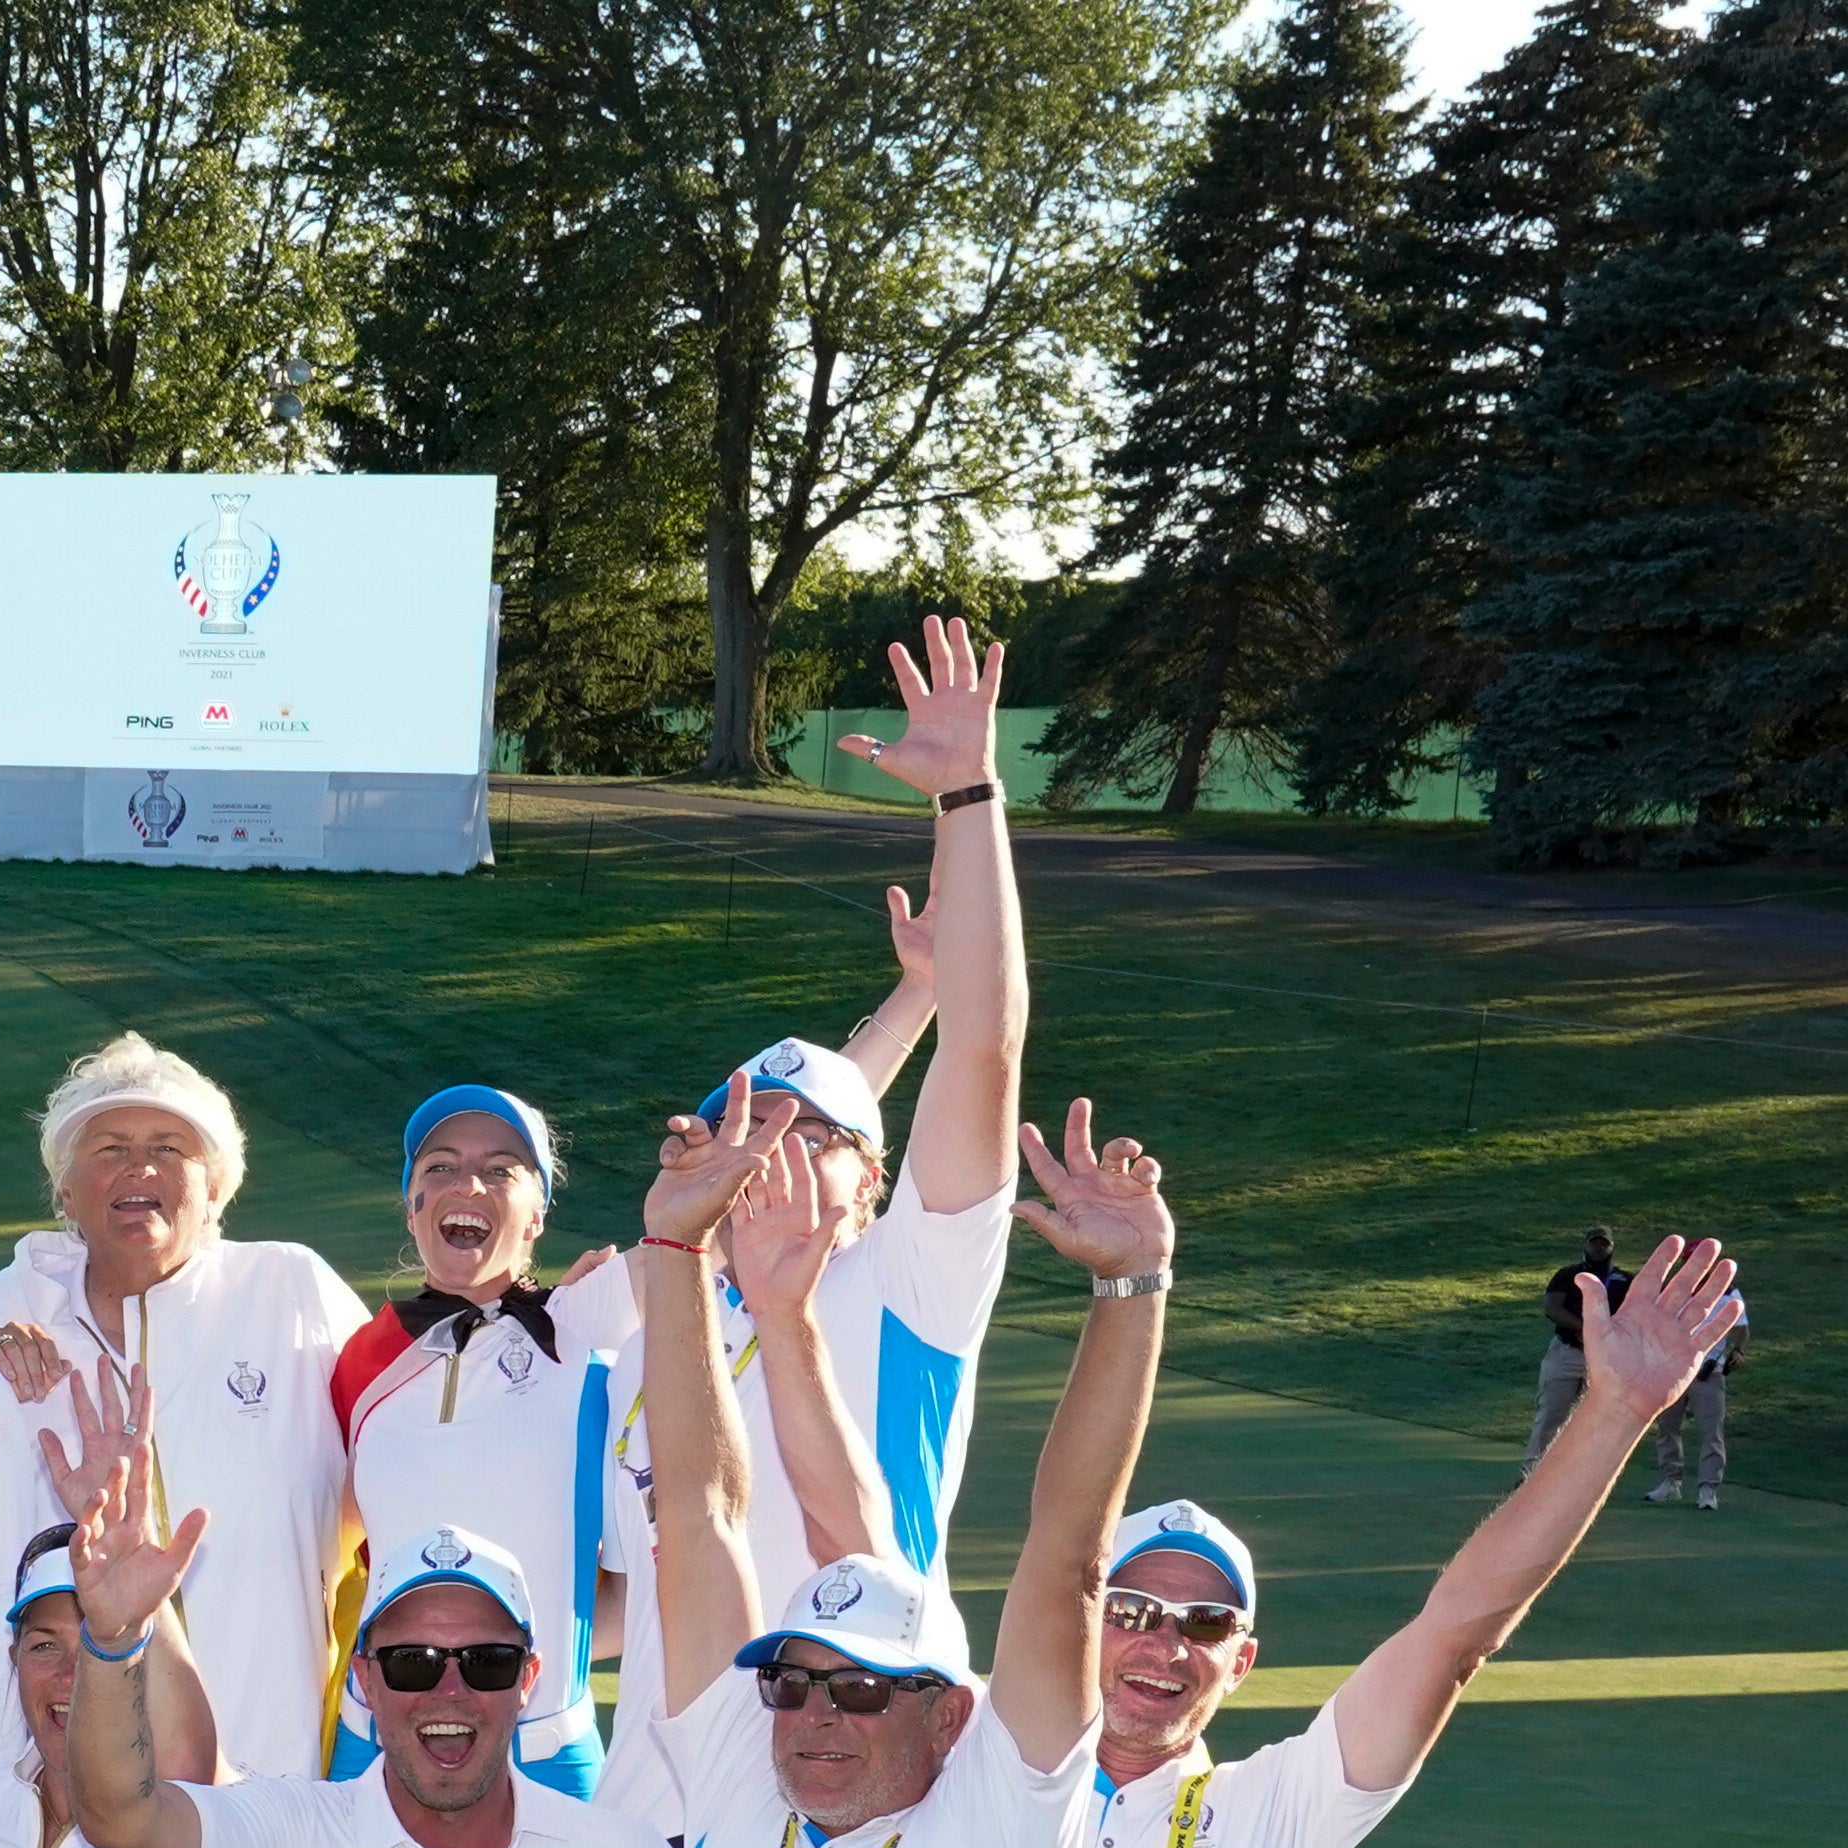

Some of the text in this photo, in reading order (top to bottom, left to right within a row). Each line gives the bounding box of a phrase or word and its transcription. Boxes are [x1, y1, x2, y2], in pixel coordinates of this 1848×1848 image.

[179, 649, 266, 659] INVERNESS CLUB
[210, 670, 233, 679] 2021
[126, 716, 174, 729] PING
[259, 721, 310, 732] ROLEX
[196, 834, 220, 843] PING
